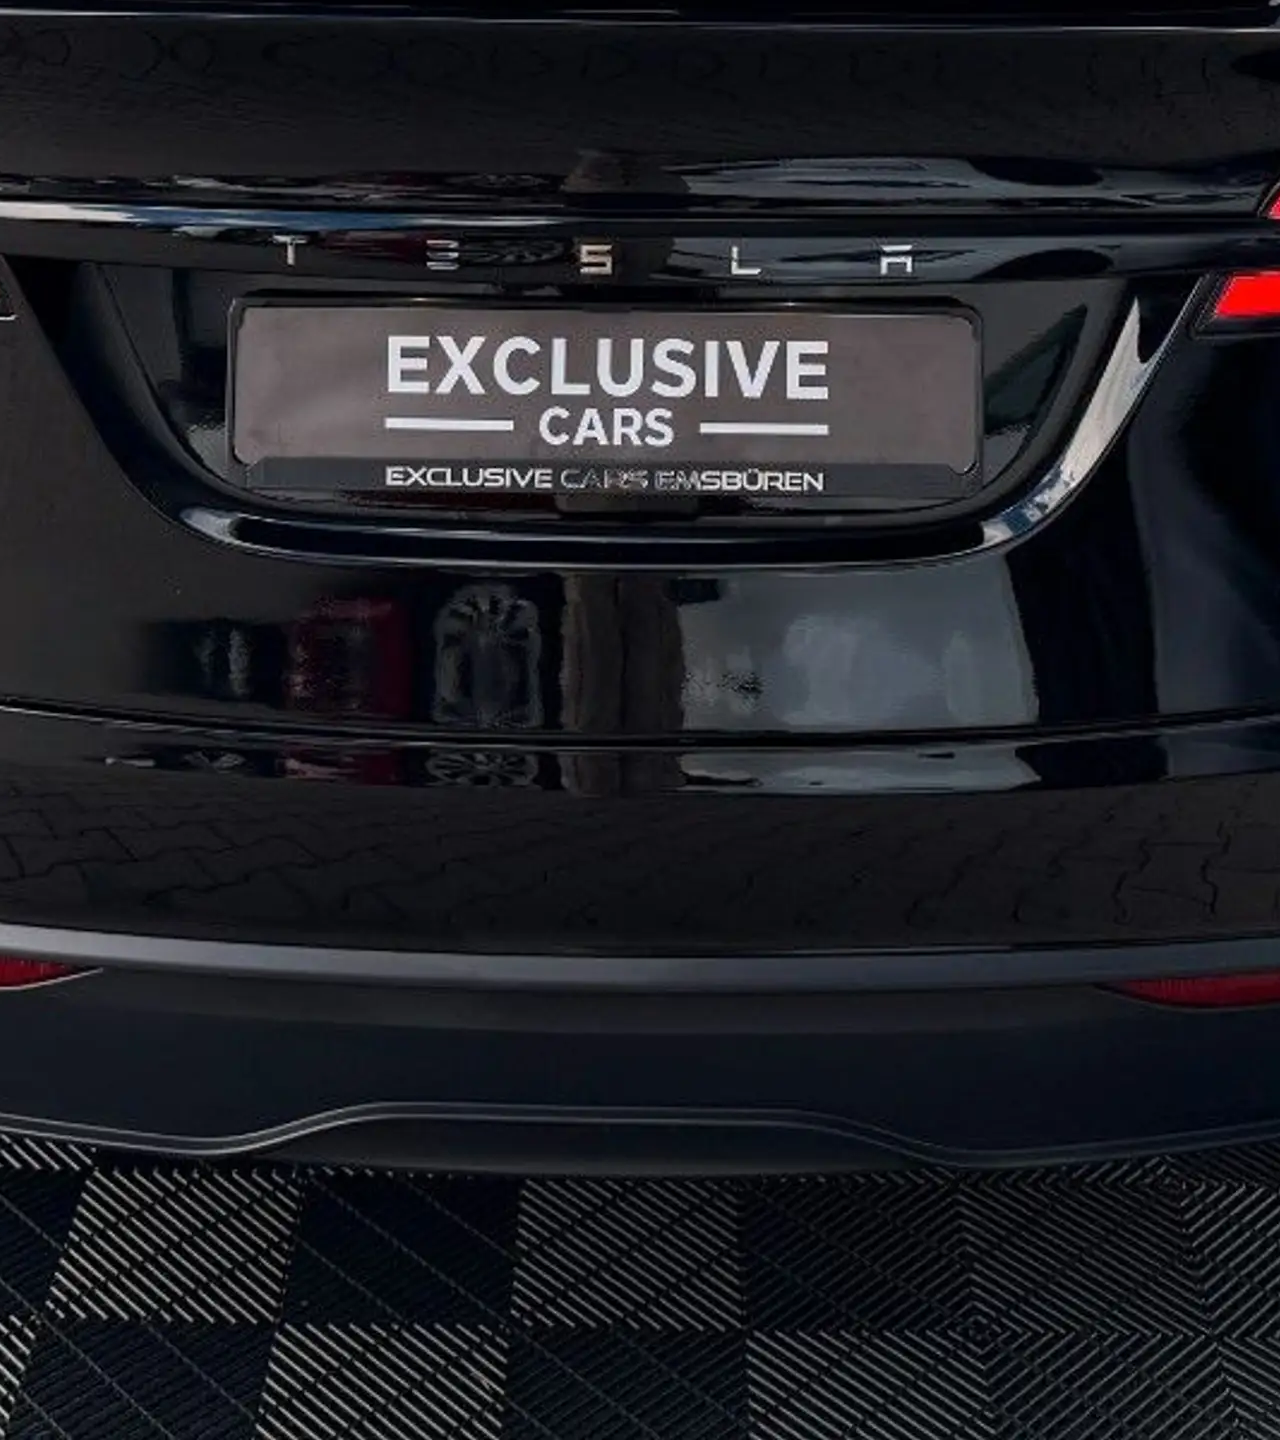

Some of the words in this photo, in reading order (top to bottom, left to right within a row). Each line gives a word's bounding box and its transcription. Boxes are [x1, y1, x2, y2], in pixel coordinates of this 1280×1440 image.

[272, 234, 915, 276] TESLA
[385, 335, 829, 400] EXCLUSIVE
[538, 406, 675, 447] CARS
[385, 465, 552, 489] EXCLUSIVE
[560, 468, 648, 490] CARS
[655, 467, 824, 492] EMSBÜREN
